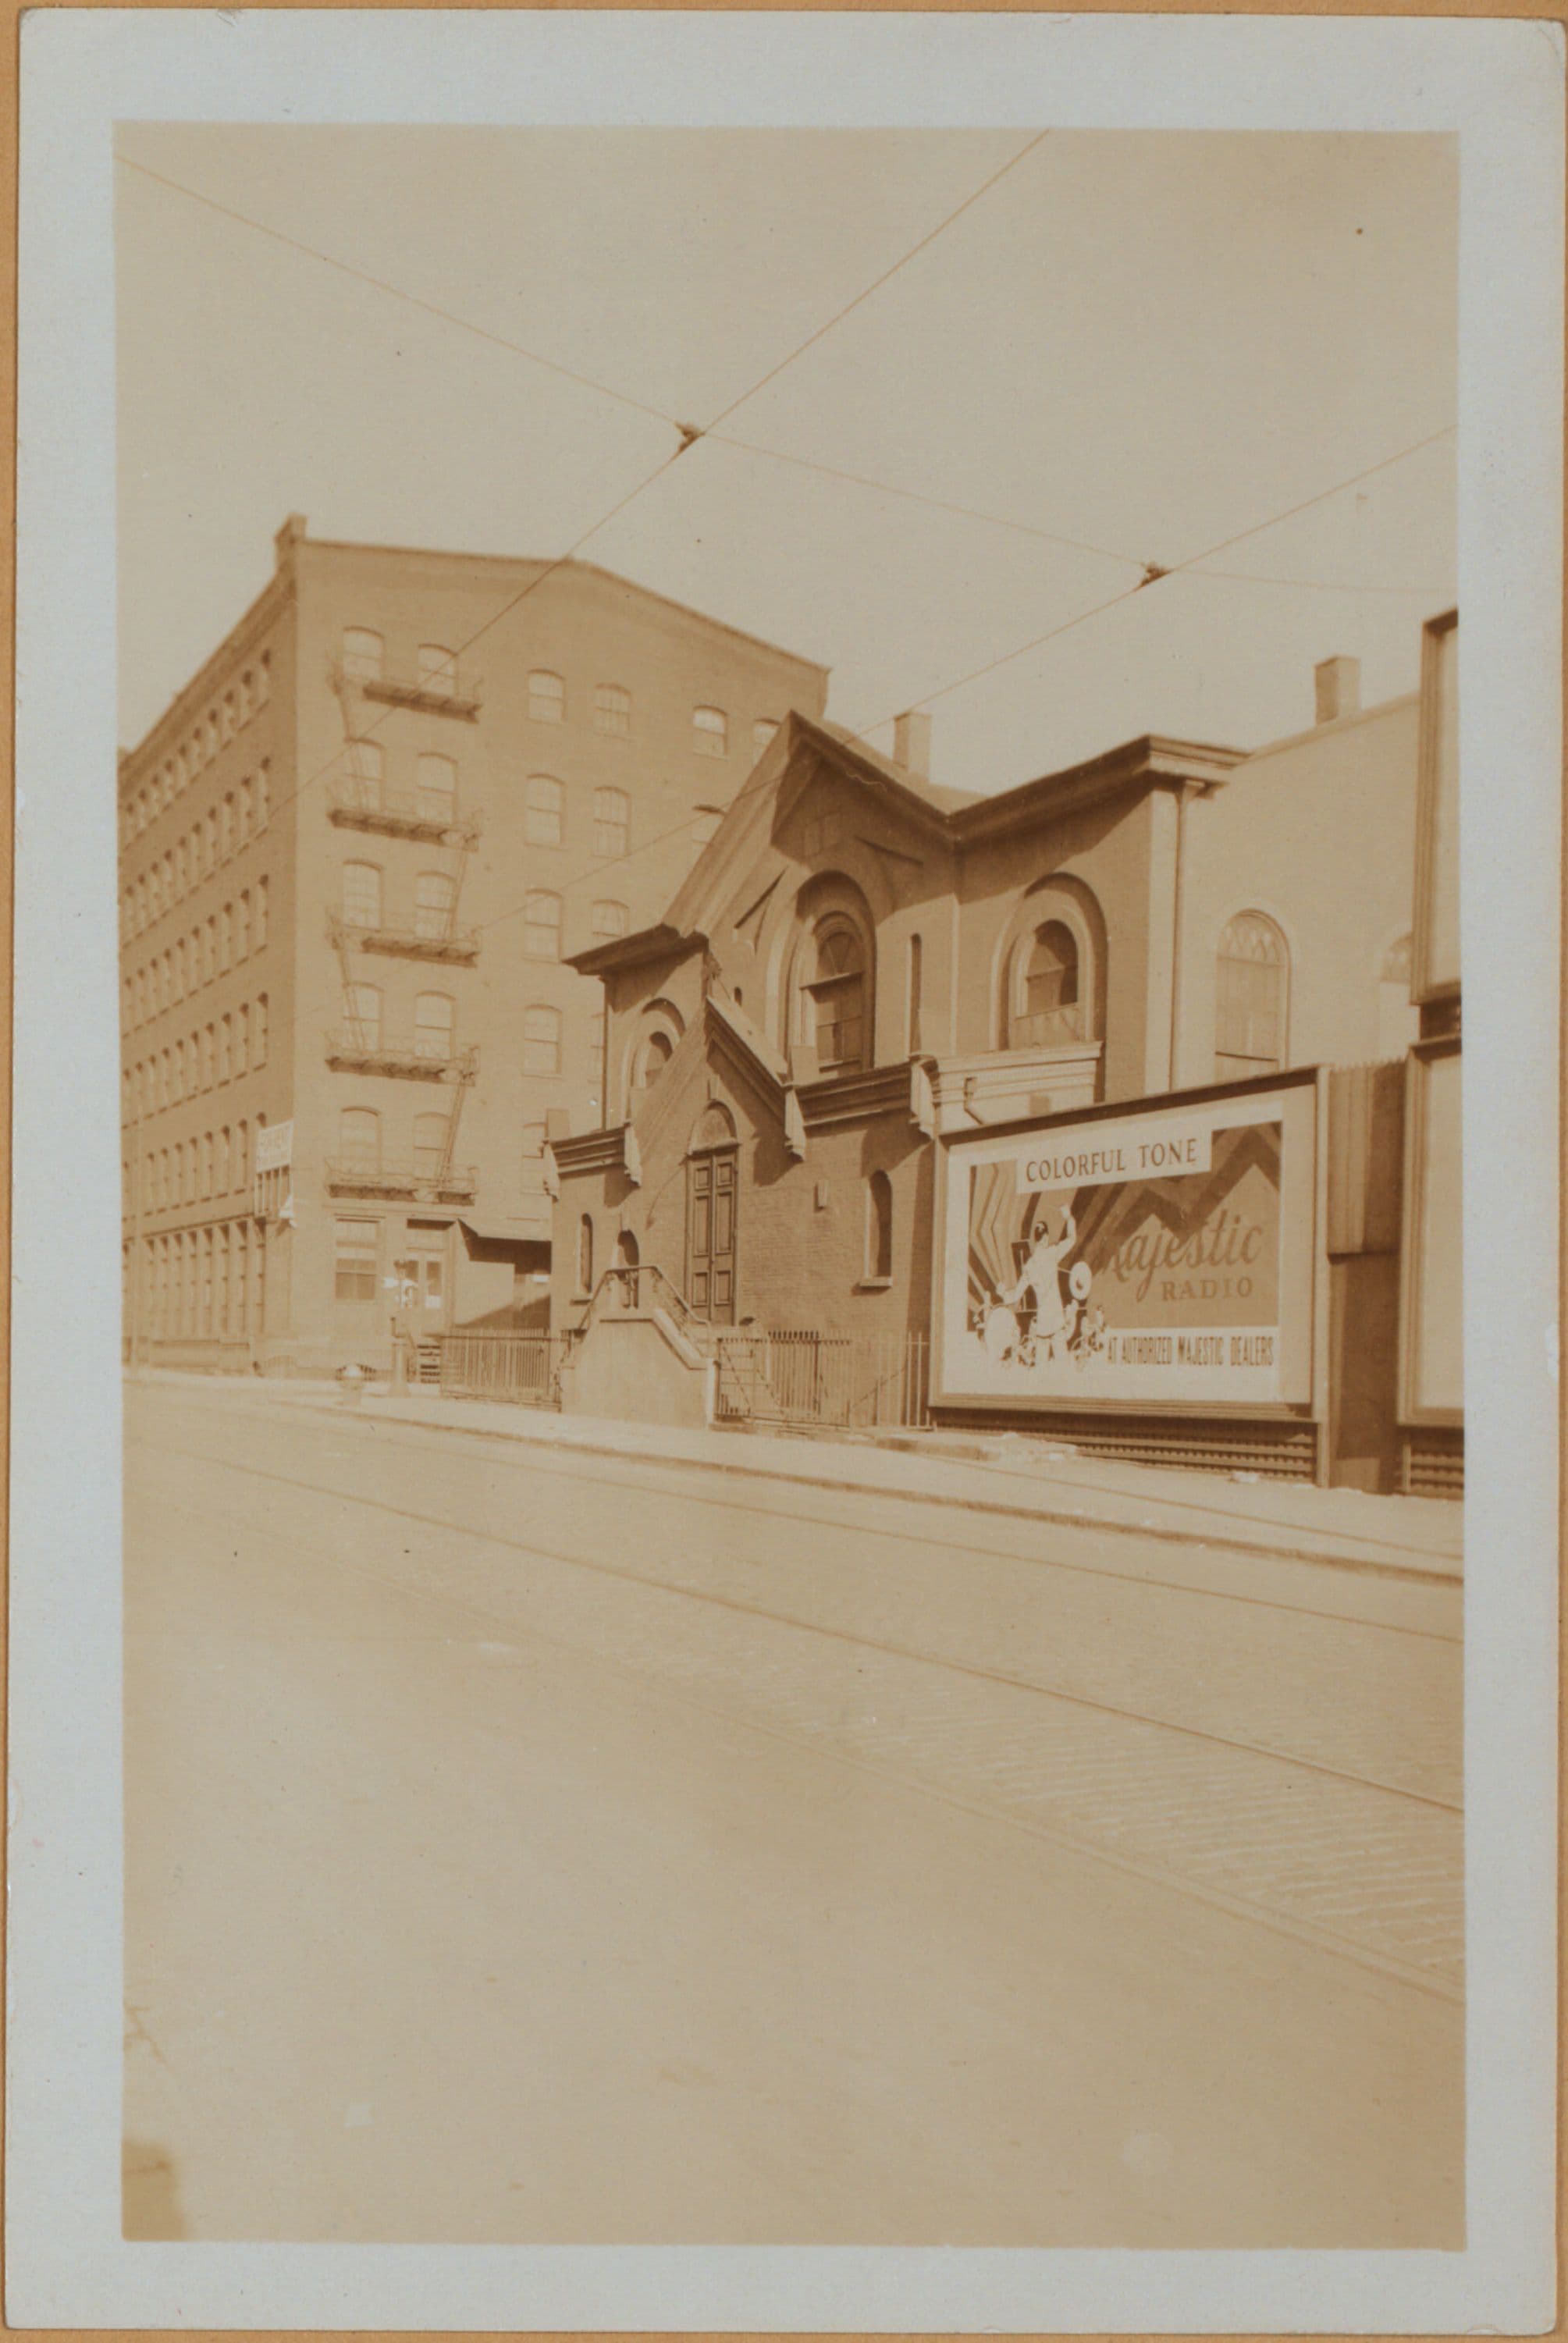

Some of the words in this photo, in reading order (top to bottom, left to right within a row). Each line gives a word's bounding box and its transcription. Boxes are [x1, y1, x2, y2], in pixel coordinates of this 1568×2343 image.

[1026, 1148, 1125, 1182] COLORFUL
[1138, 1138, 1197, 1168] TONE
[1093, 1207, 1264, 1303] Majestic
[1161, 1276, 1253, 1302] RADIO
[1107, 1335, 1118, 1364] AT
[1122, 1335, 1172, 1365] AUTHORIZED
[1177, 1335, 1224, 1366] MAJESTIC
[1229, 1335, 1275, 1367] DEALERS
